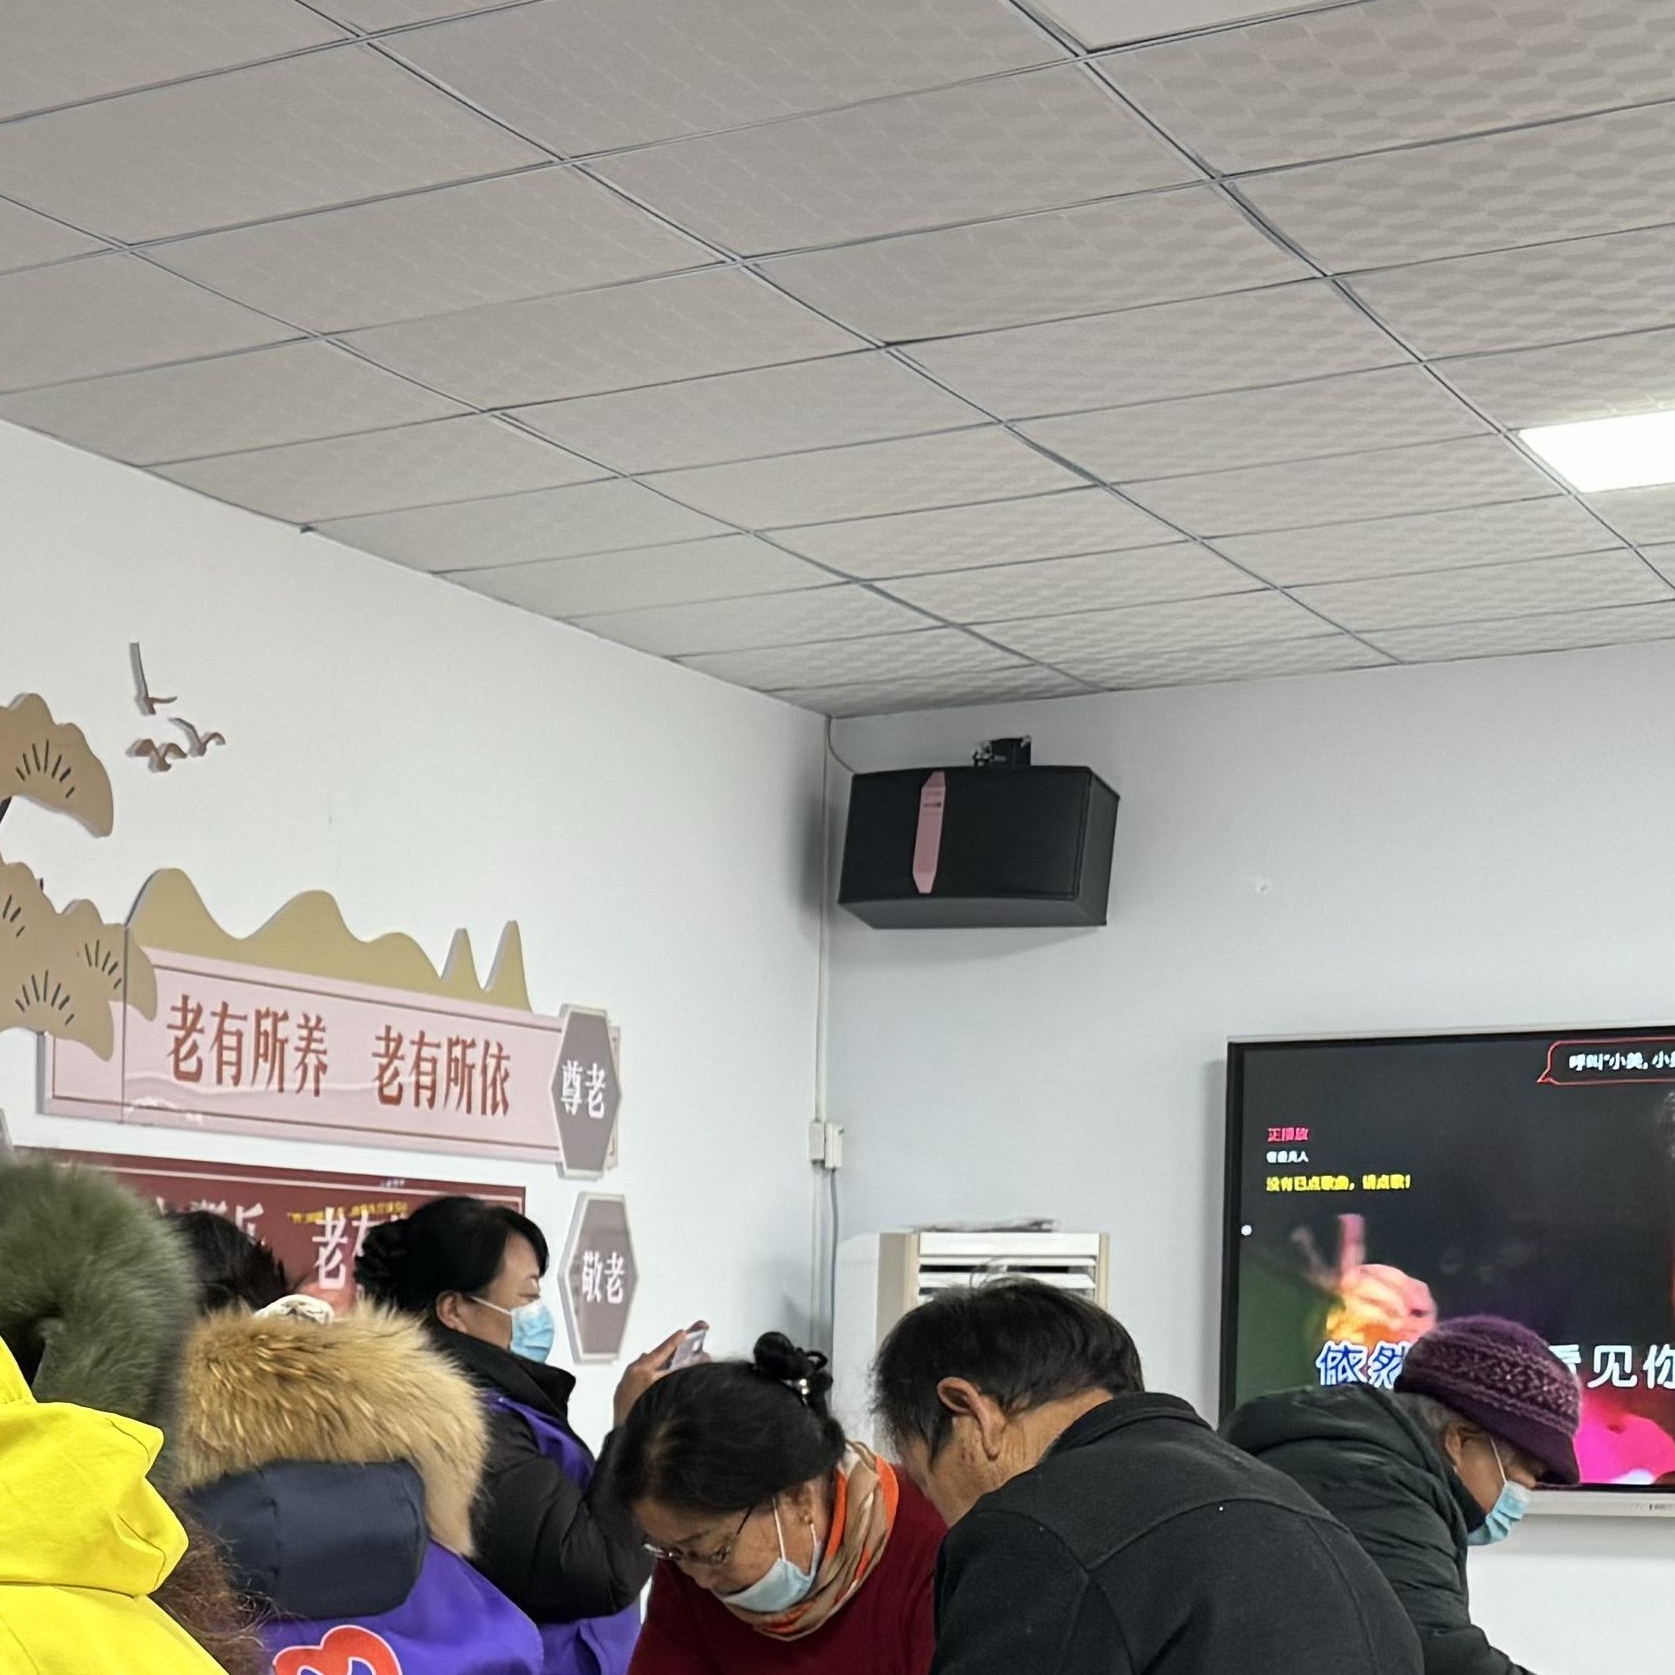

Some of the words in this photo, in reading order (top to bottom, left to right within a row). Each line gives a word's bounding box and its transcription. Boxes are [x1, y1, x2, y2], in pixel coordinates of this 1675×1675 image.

[165, 994, 329, 1096] 老有所养
[370, 1025, 513, 1118] 老有所依
[560, 1059, 608, 1119] 尊老
[581, 1250, 627, 1305] 敬老
